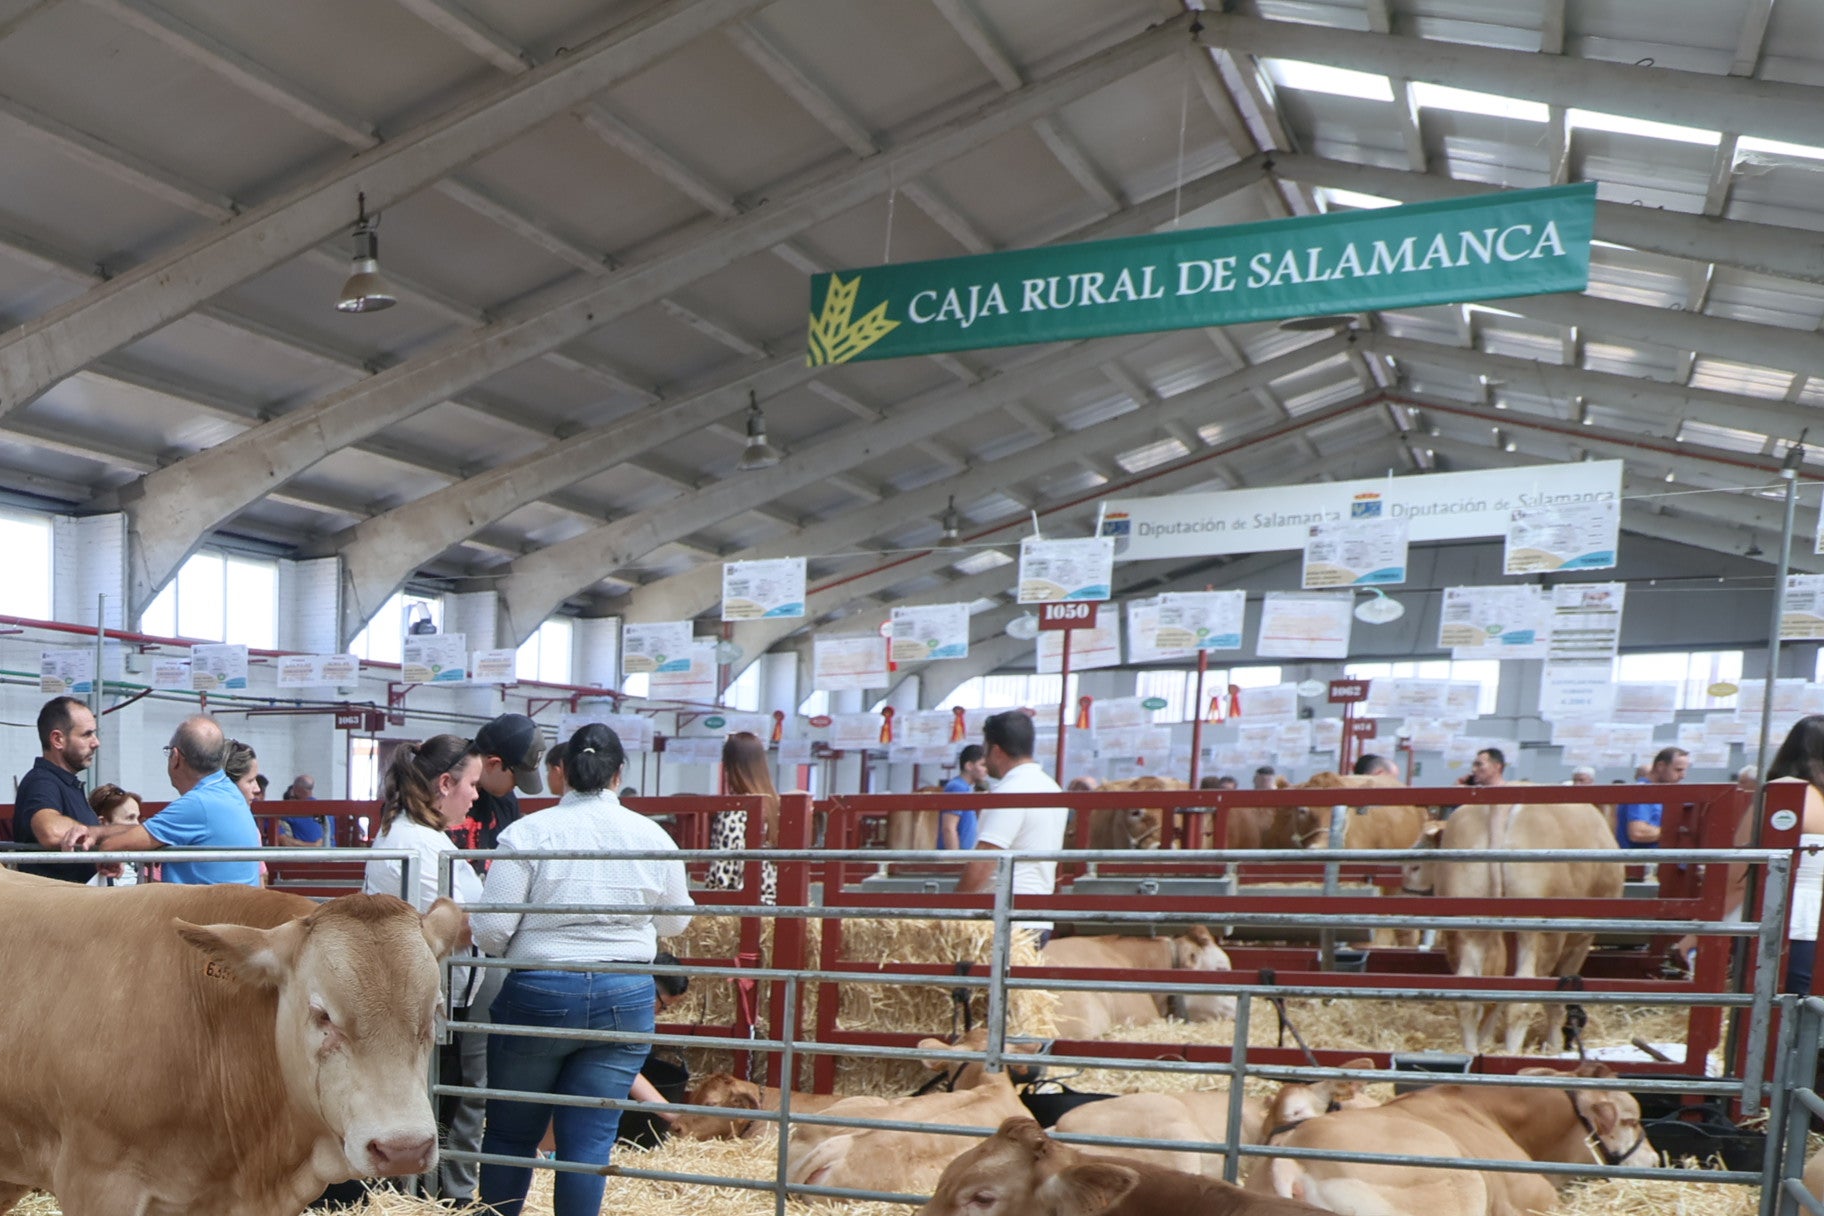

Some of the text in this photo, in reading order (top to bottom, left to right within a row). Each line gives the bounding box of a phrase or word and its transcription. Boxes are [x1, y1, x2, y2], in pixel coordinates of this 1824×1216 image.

[908, 219, 1567, 329] CAJA RURAL DE SALAMANCA
[1390, 498, 1487, 519] Diputación
[1494, 500, 1510, 511] de
[1138, 517, 1226, 538] Diputación
[1231, 519, 1247, 531] de
[1045, 603, 1090, 620] 1050
